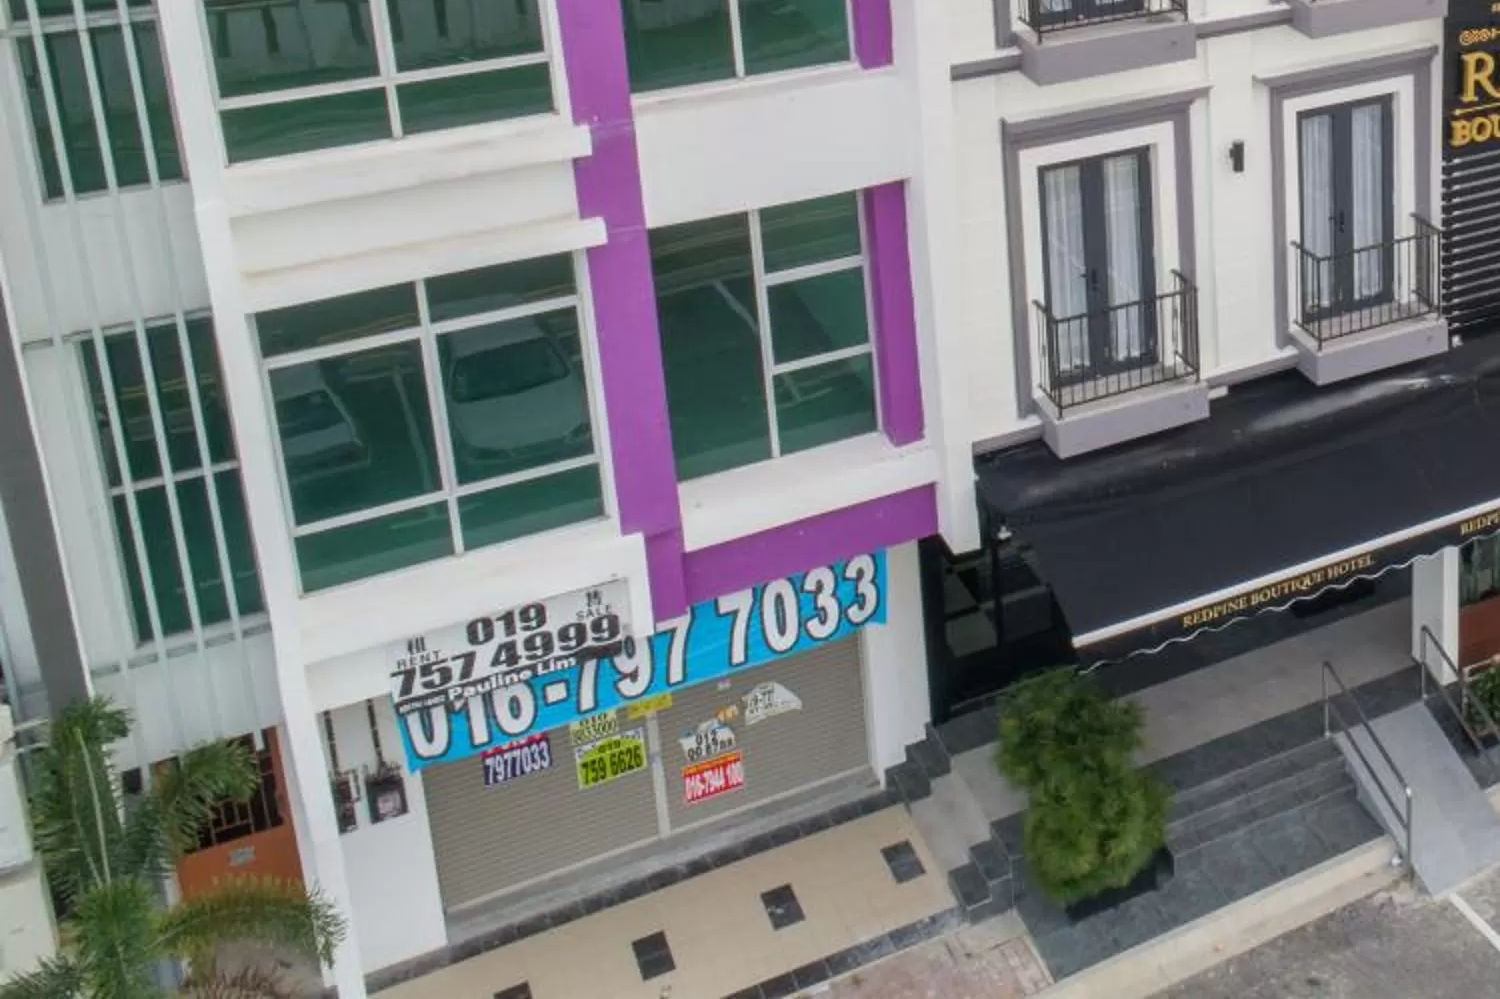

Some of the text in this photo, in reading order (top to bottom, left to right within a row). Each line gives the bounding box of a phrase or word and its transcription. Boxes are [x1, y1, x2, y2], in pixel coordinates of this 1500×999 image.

[716, 553, 880, 667] 7033
[1182, 554, 1375, 629] REDPINE BOUTIQUE HOTEL
[466, 602, 548, 646] 019
[390, 614, 621, 699] 757 4999
[396, 648, 442, 669] RENT
[450, 656, 577, 702] Pauline Lim
[484, 740, 551, 786] 7977033
[581, 756, 607, 785] 759
